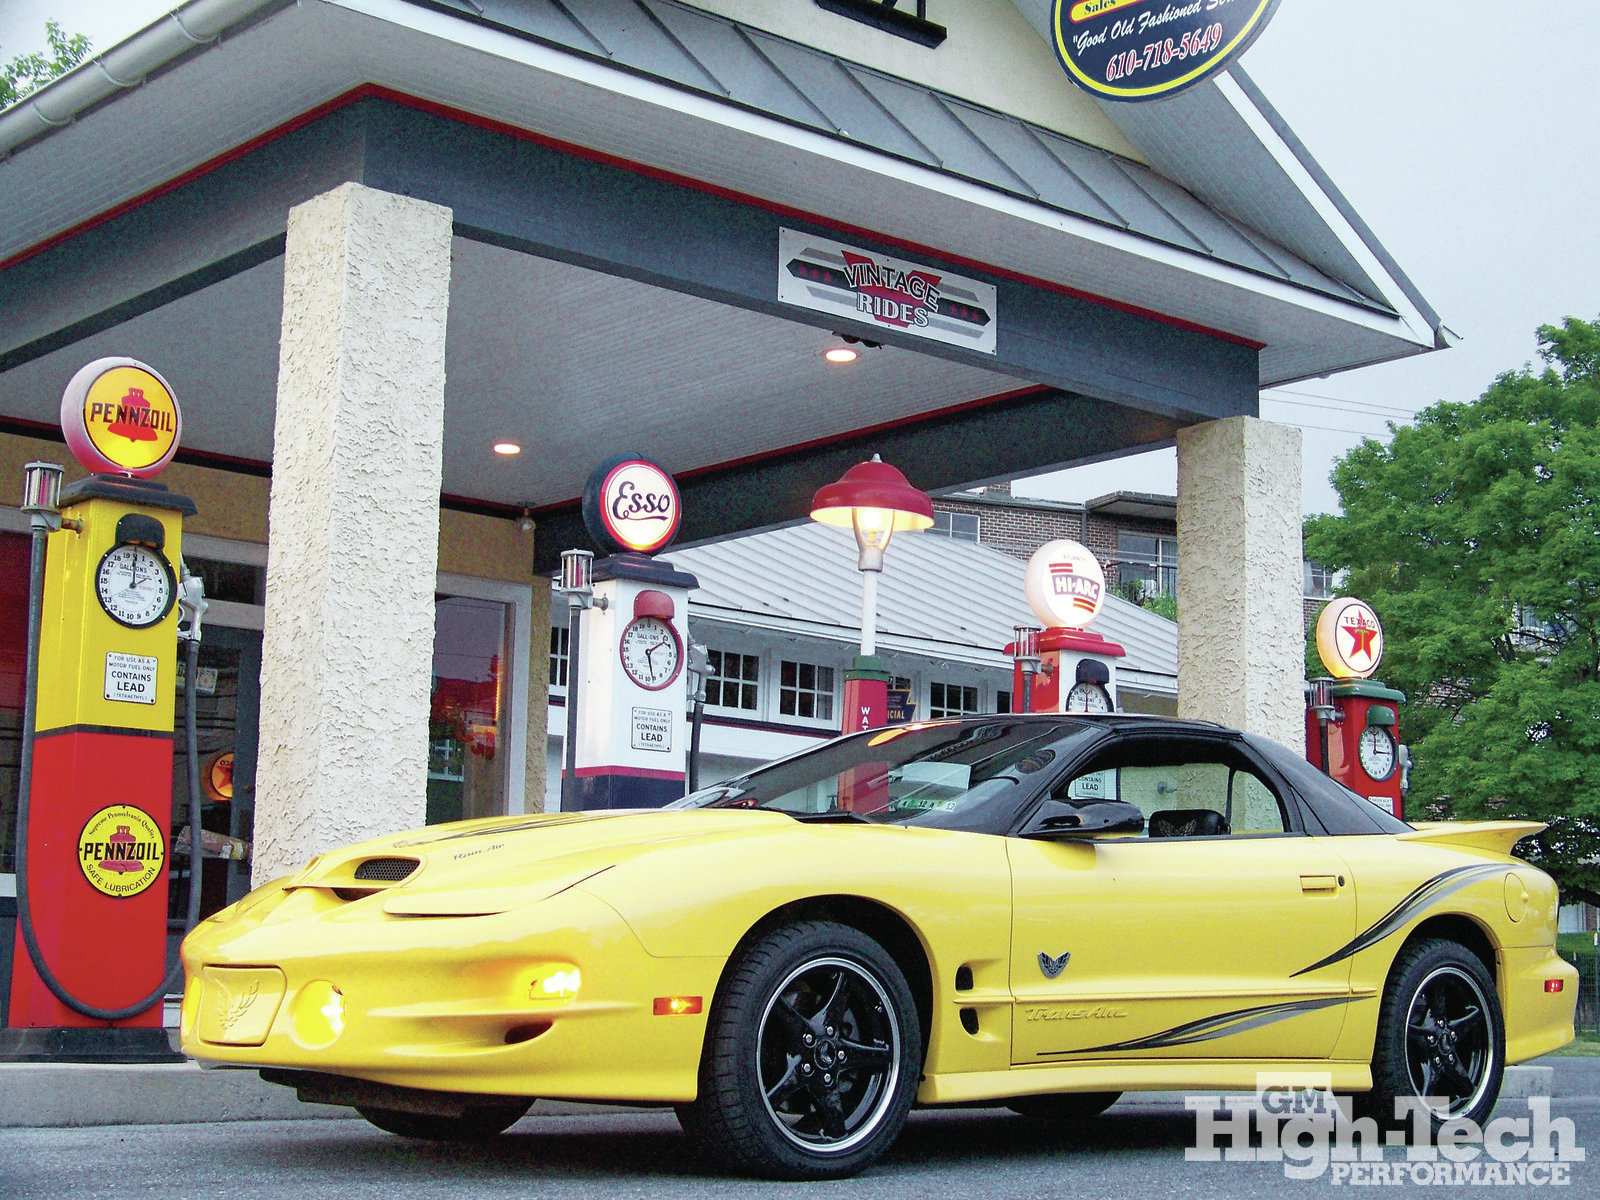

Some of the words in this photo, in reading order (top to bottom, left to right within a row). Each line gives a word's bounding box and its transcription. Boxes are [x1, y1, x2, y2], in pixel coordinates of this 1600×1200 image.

[1111, 17, 1135, 40] Old
[1138, 0, 1201, 35] Fashioned
[1106, 22, 1222, 82] 610-718-5649
[843, 263, 941, 313] VINTAGE
[857, 291, 929, 327] RIDES
[89, 402, 173, 433] PENNZOIL
[612, 480, 671, 521] Esso
[1055, 576, 1099, 600] HI-ARC
[1344, 616, 1376, 629] TEXACO
[112, 670, 152, 682] CONTAINS
[117, 682, 145, 692] LEAD
[861, 707, 870, 730] WAT
[888, 710, 905, 719] ICIAL
[636, 723, 668, 732] CONTAINS
[641, 732, 663, 742] LEAD
[1082, 782, 1098, 790] LEAD
[84, 842, 160, 860] PENNZOIL
[86, 864, 104, 885] SAFE
[104, 866, 156, 892] LUBRICATION
